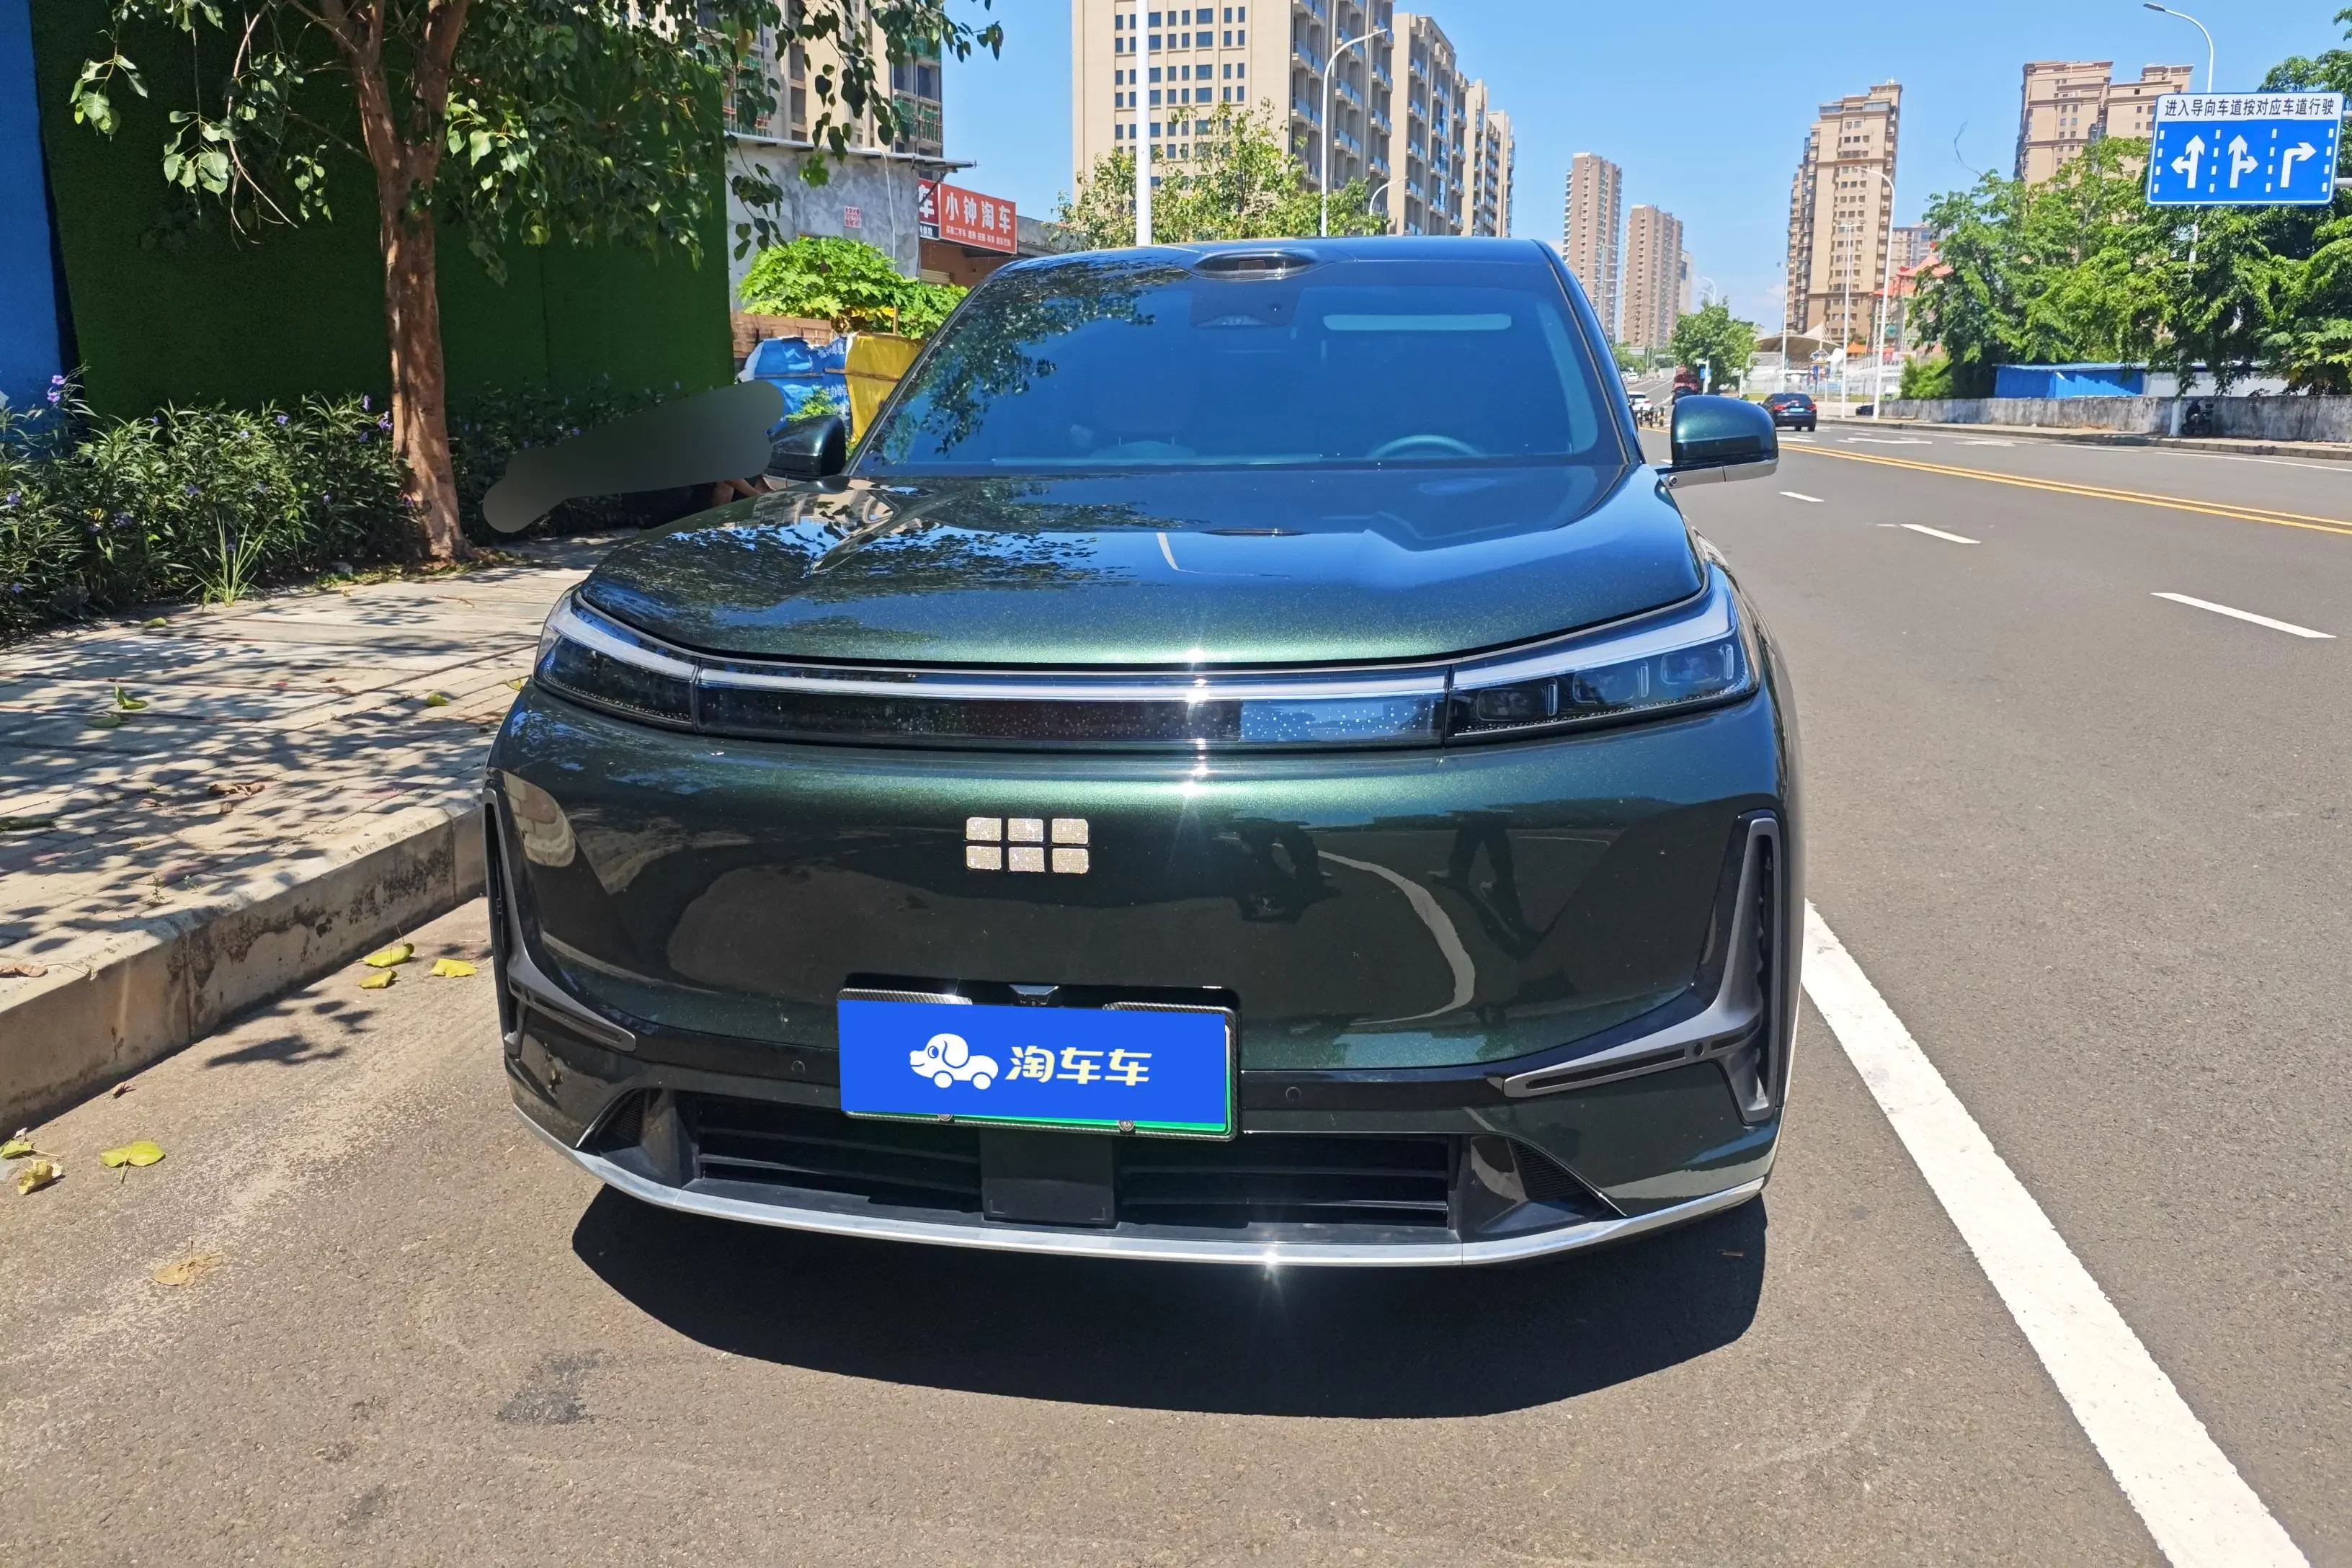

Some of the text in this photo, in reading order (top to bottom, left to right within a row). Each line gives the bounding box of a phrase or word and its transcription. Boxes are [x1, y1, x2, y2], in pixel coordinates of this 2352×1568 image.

[2164, 97, 2335, 117] 进入导向车道按对应车道行驶
[945, 192, 1012, 234] 小钟淘车
